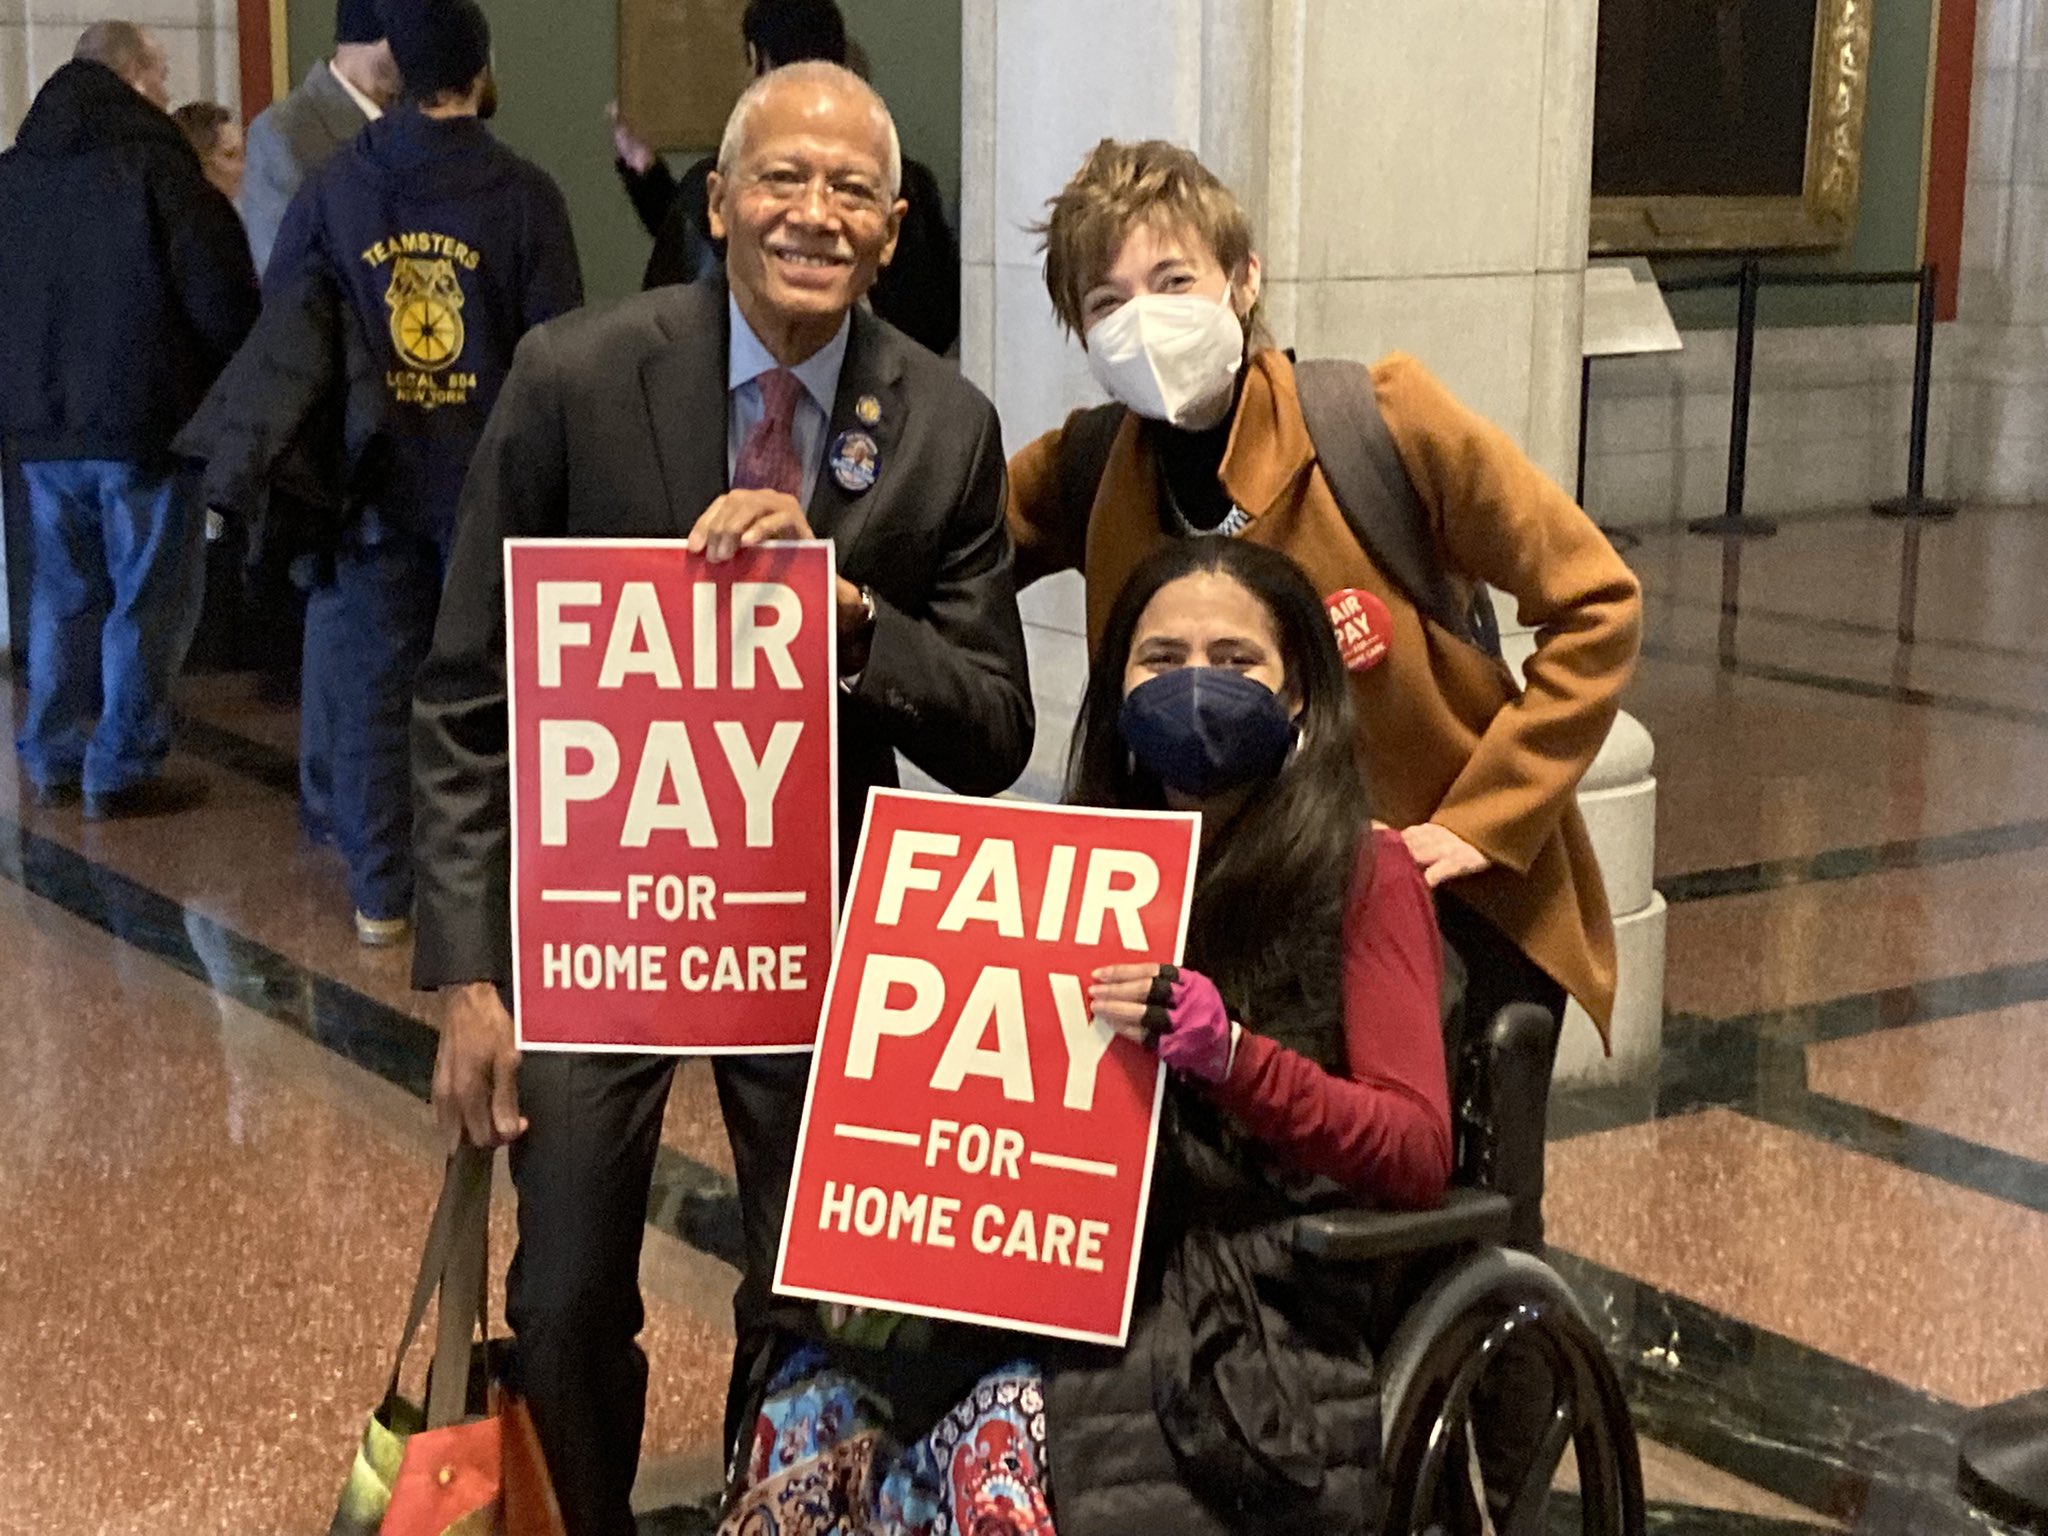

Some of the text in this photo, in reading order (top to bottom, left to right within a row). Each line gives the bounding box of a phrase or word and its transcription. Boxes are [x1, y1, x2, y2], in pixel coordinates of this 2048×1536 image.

[362, 232, 480, 271] TEAMSTERS
[386, 370, 437, 389] LOCAL
[536, 581, 804, 690] FAIR
[1330, 595, 1362, 625] AIR
[538, 719, 805, 848] PAY
[627, 874, 717, 921] FOR
[874, 829, 1160, 951] FAIR
[542, 943, 807, 992] HOME CARE
[844, 953, 1116, 1112] PAY
[925, 1119, 1025, 1180] FOR
[818, 1181, 1110, 1272] HOME CARE
